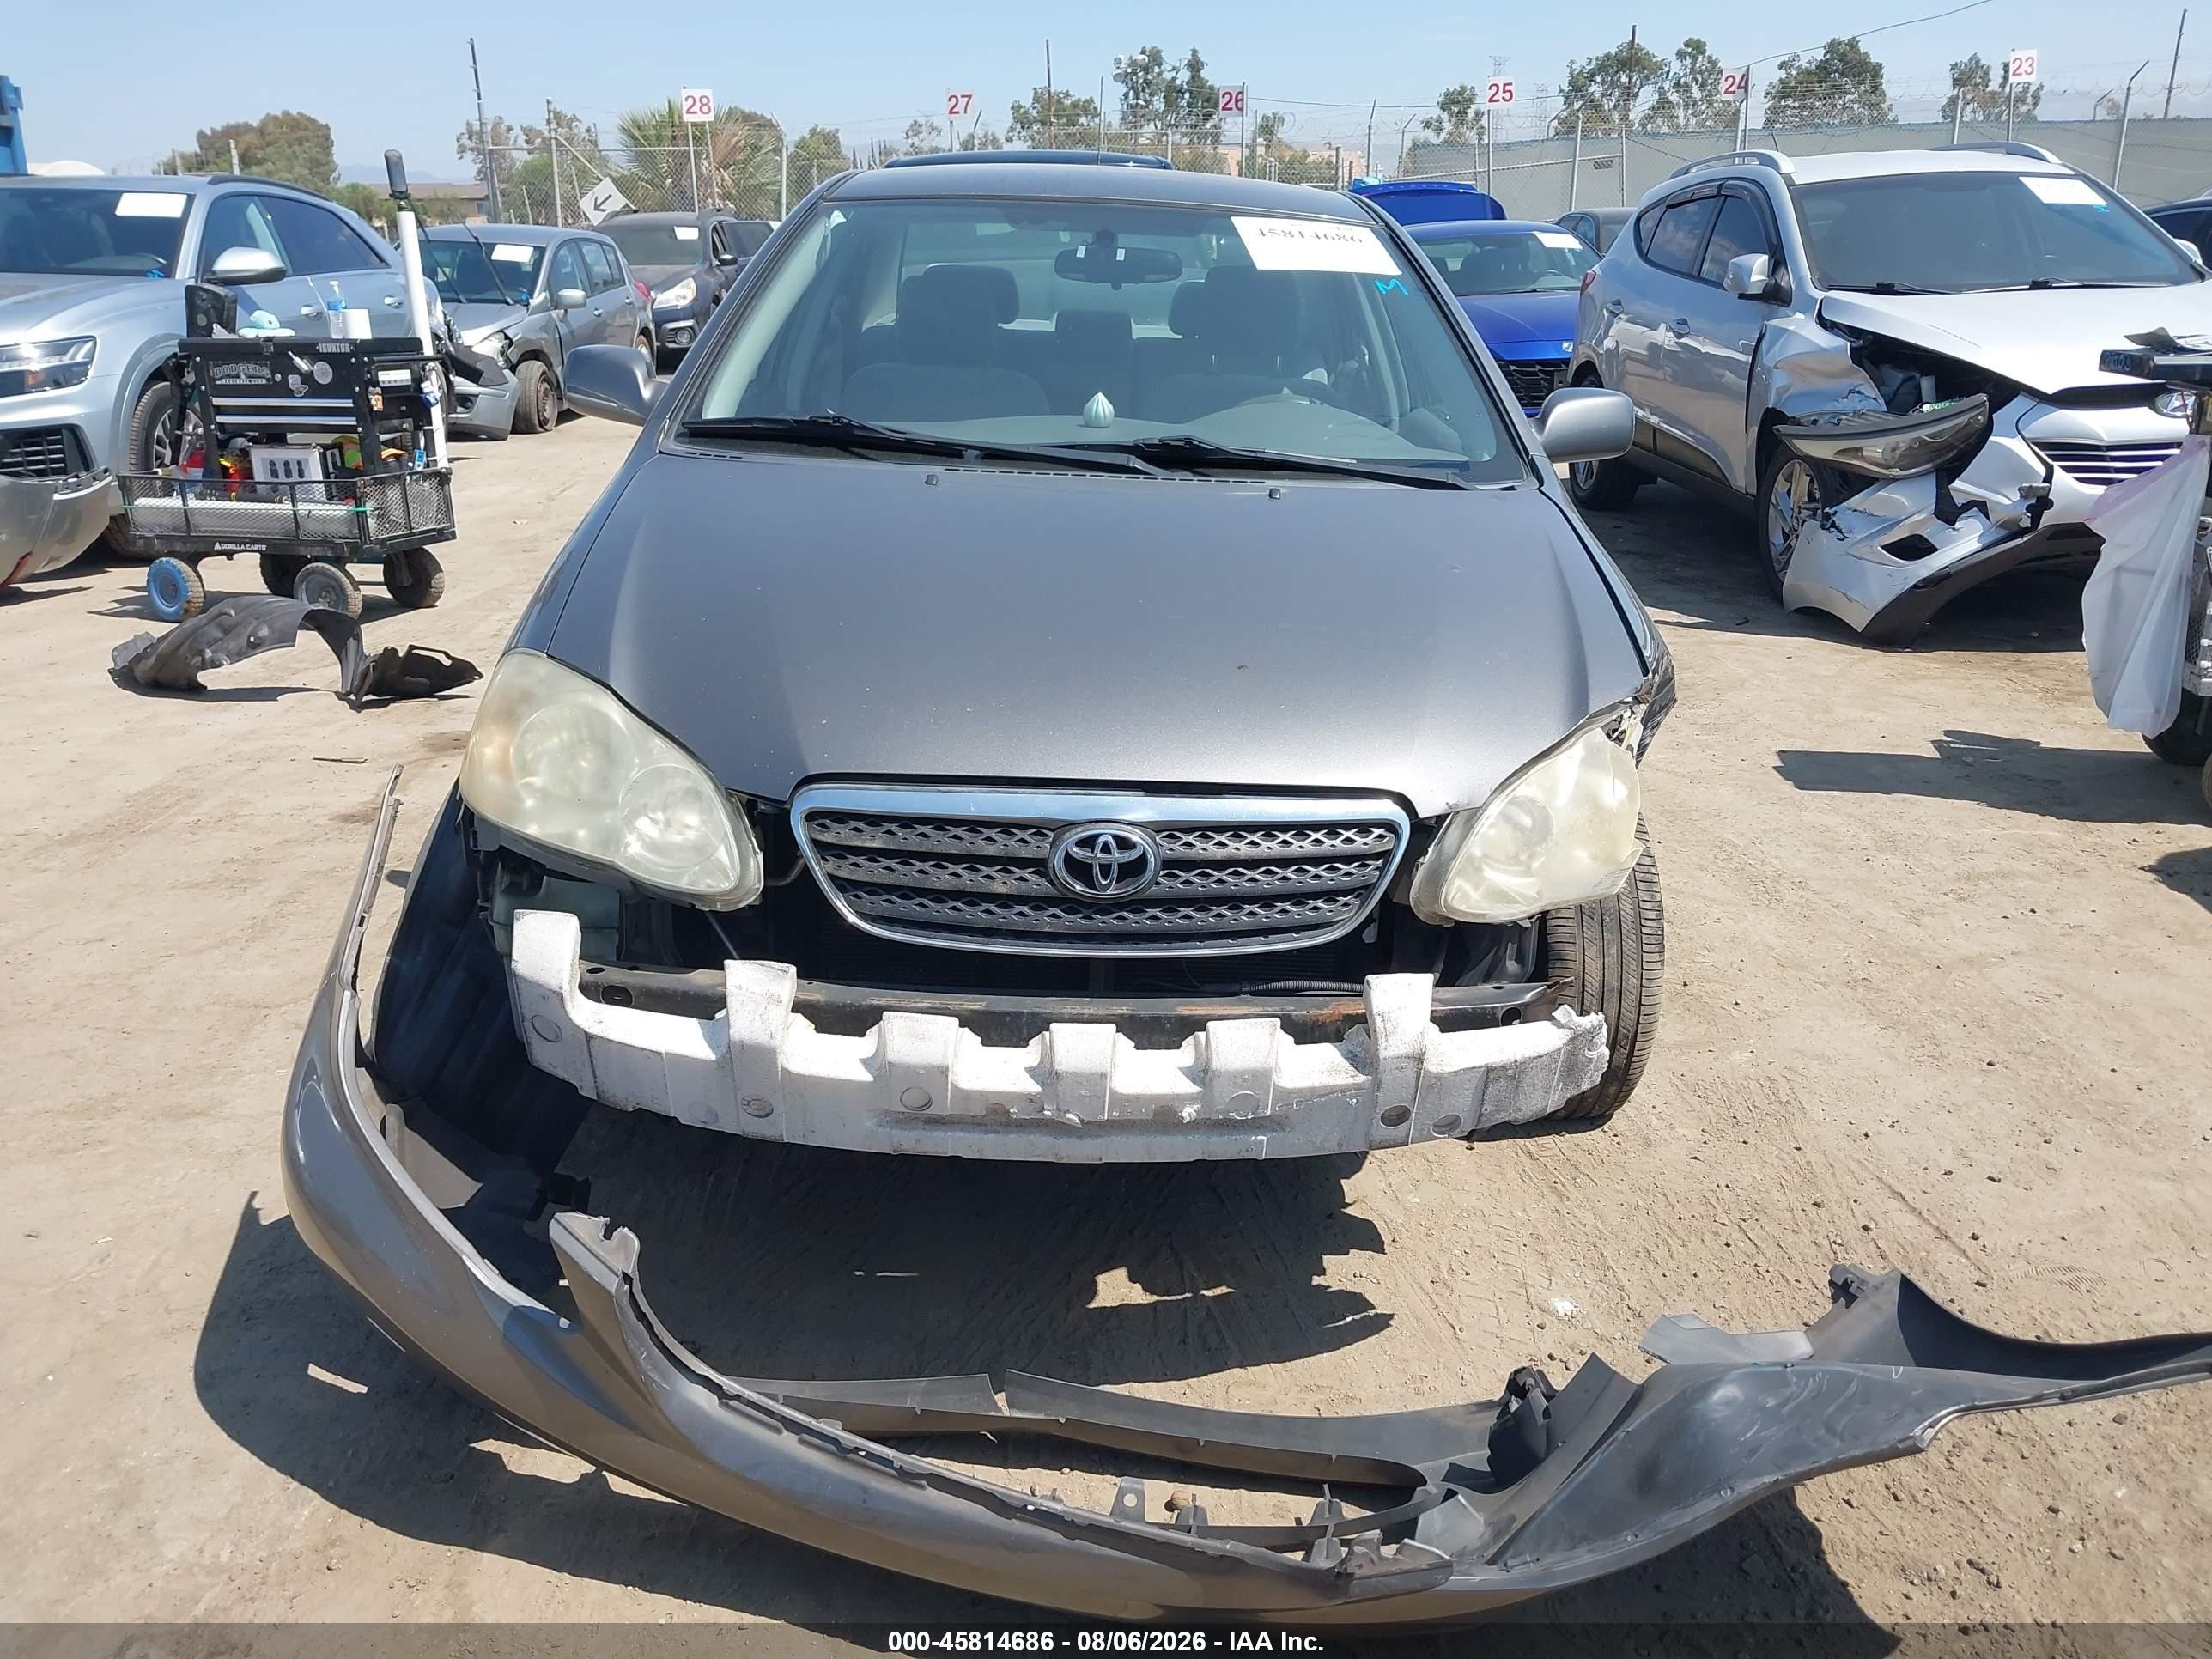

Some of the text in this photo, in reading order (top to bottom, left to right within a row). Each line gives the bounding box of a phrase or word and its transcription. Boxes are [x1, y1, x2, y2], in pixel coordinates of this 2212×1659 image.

[2012, 57, 2034, 76] 23
[1488, 82, 1513, 103] 25
[1723, 74, 1747, 94] 24
[685, 94, 712, 115] 28
[948, 94, 972, 114] 27
[1221, 91, 1243, 112] 26
